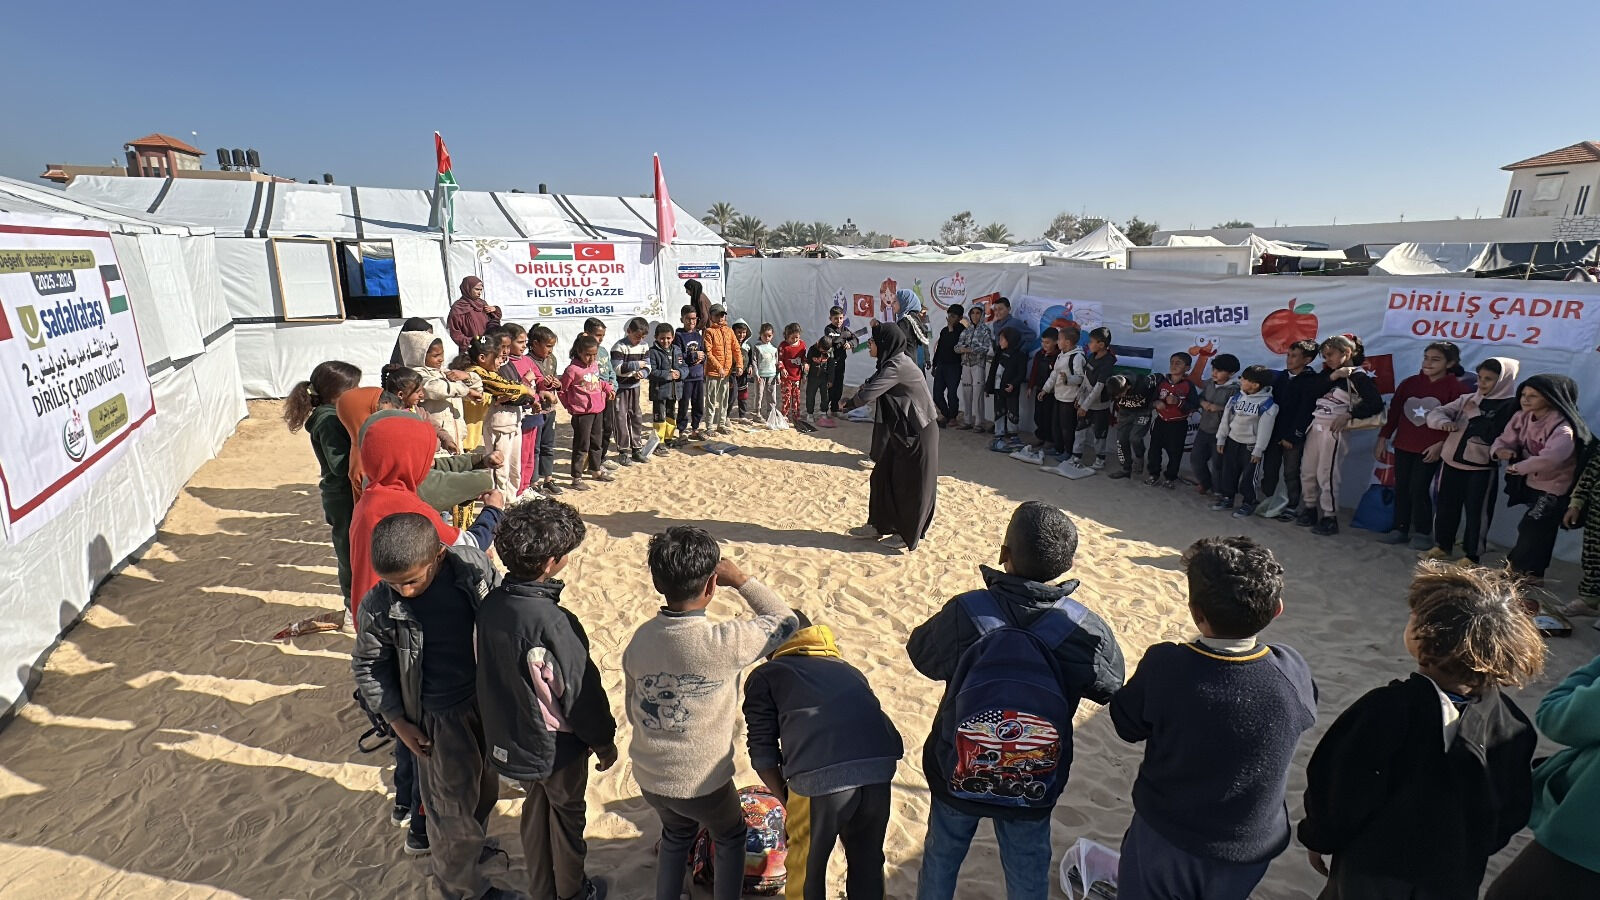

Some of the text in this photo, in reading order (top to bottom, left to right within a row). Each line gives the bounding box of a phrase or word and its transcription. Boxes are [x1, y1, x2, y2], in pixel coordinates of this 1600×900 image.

[515, 262, 625, 276] DİRİLİŞ ÇADIR
[527, 288, 576, 297] FİLİSTİN
[586, 288, 624, 297] GAZZE
[555, 305, 614, 315] sadakataşı
[1388, 290, 1584, 320] DİRİLİŞ ÇADIR
[40, 297, 106, 339] sadakataşı
[1154, 306, 1248, 328] sadakataşı
[32, 380, 71, 417] DİRİLİŞ
[69, 371, 96, 404] ÇADIR
